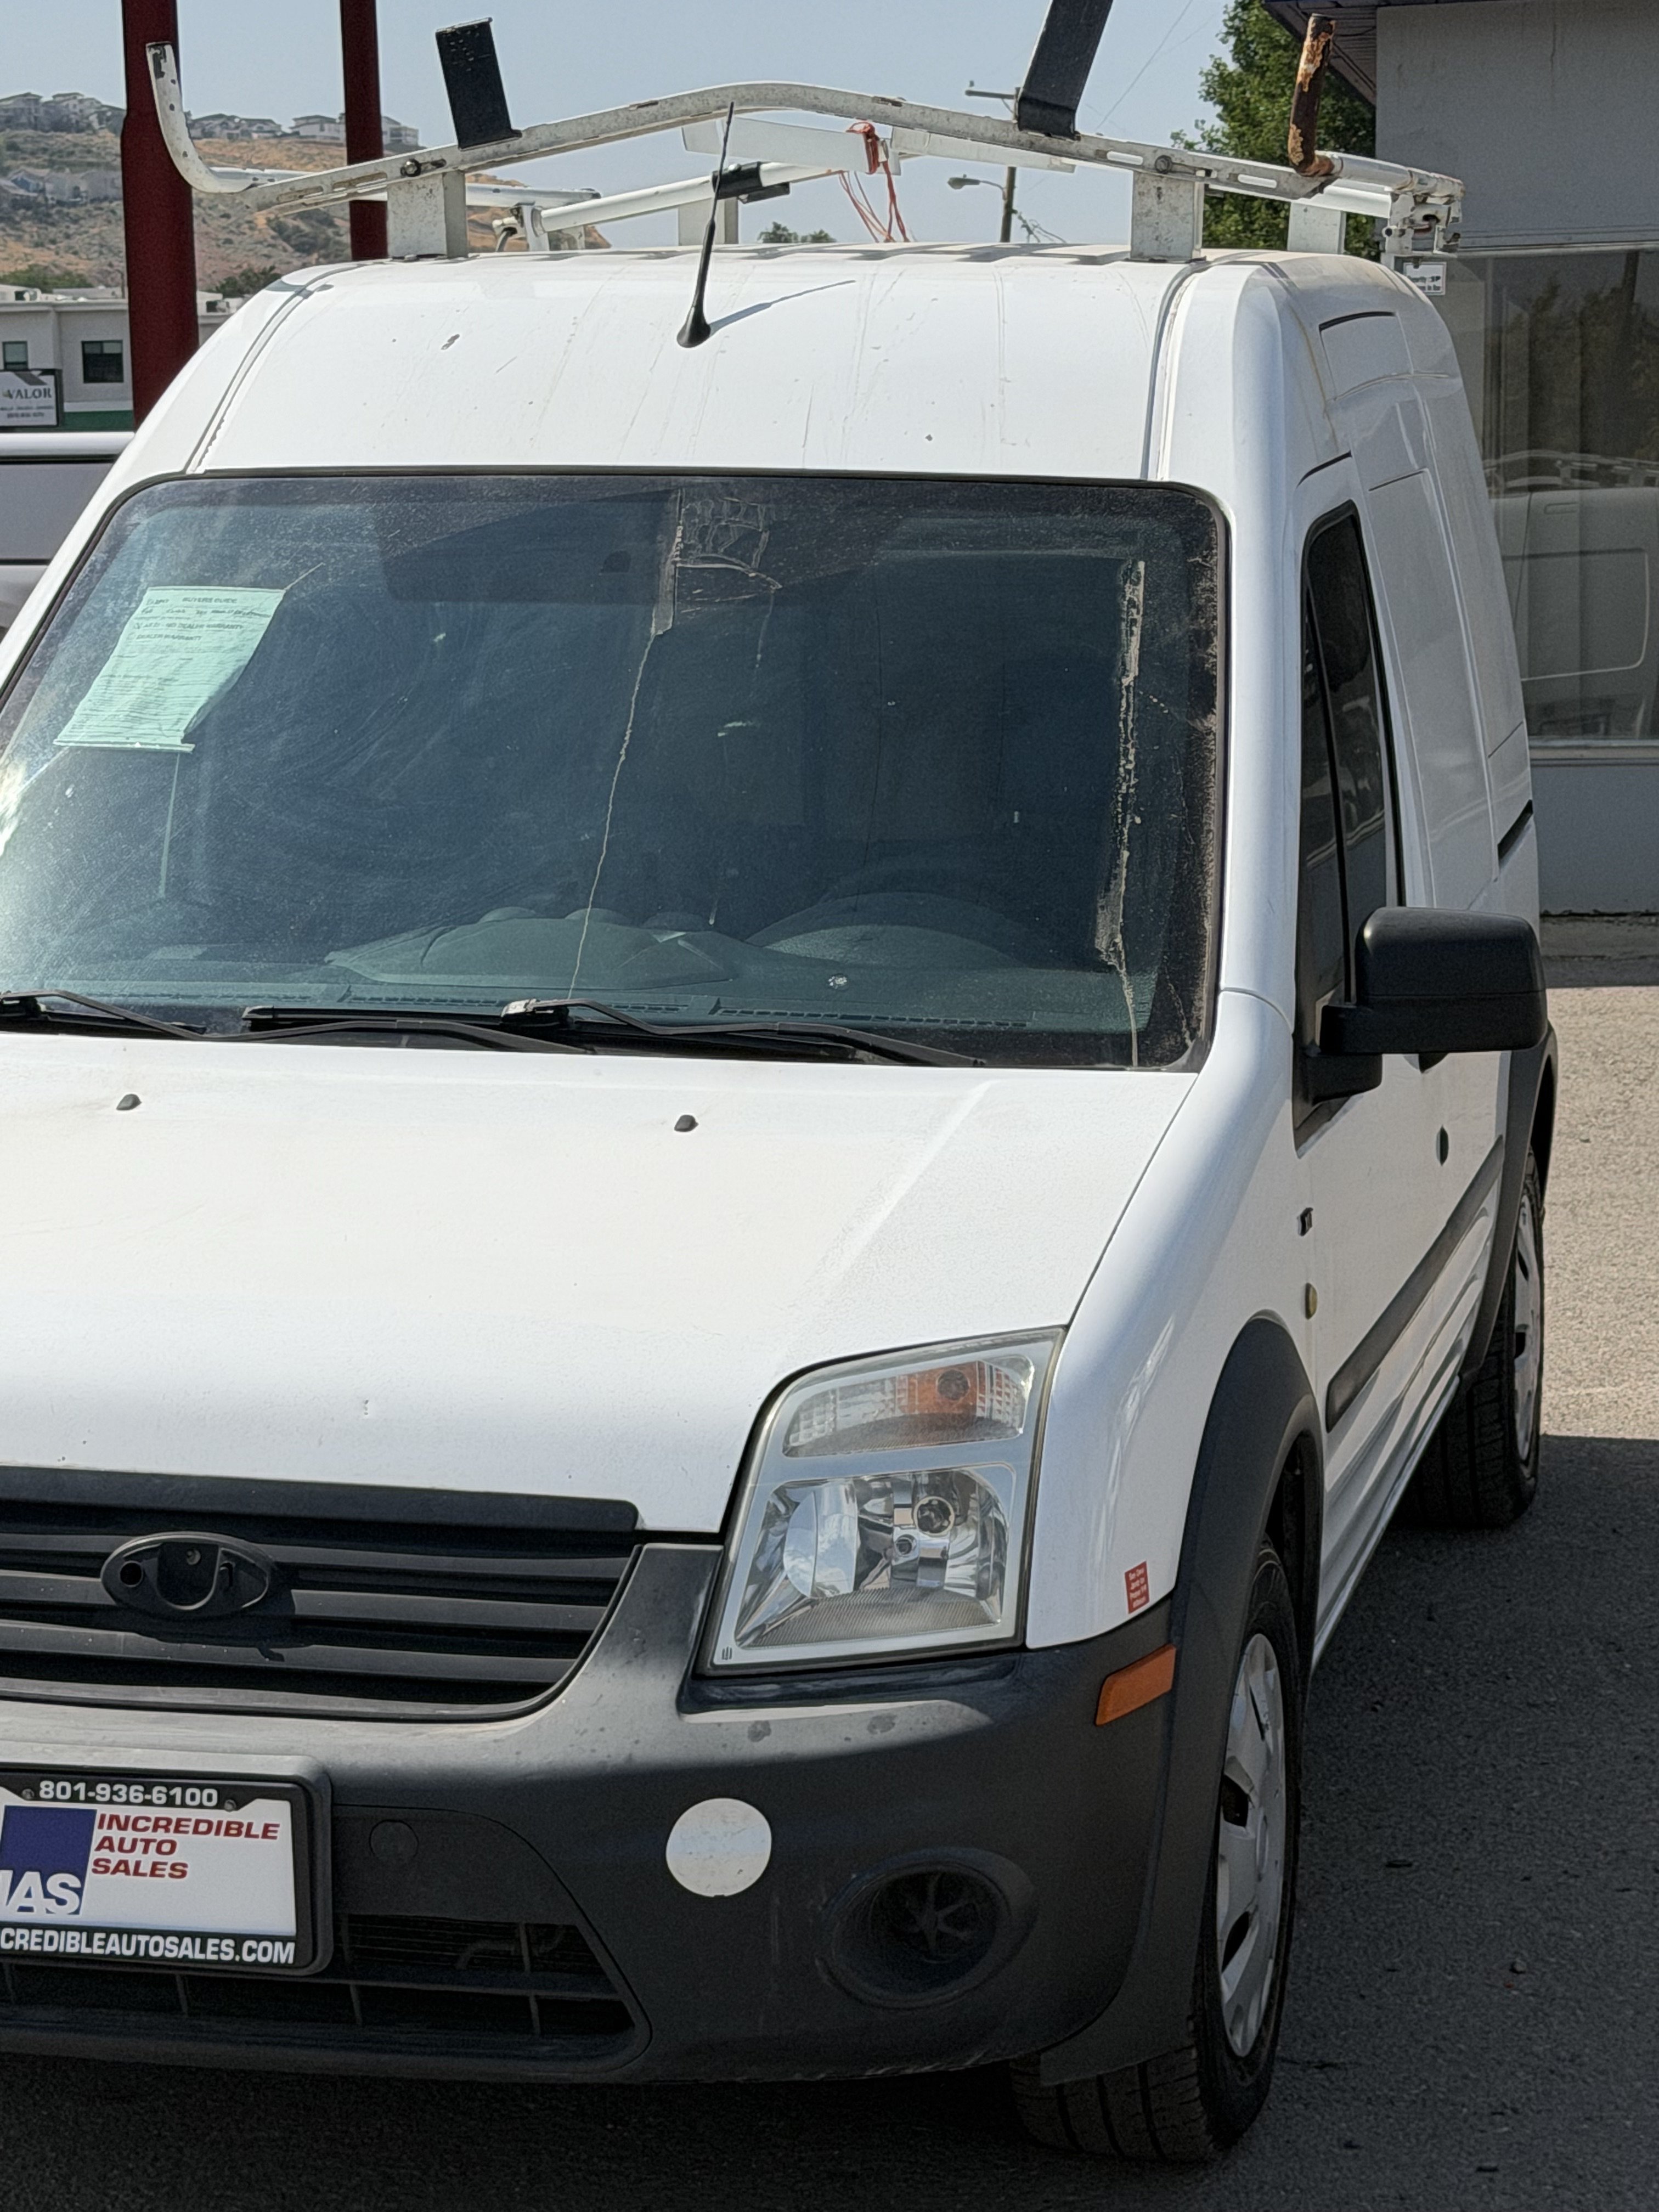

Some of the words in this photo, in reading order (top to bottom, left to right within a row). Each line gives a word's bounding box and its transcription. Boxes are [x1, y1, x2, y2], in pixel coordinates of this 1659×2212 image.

[40, 1780, 218, 1807] 801-936-6100
[97, 1813, 281, 1840] INCREDIBLE
[95, 1836, 177, 1855] AUTO
[92, 1858, 189, 1878] SALES
